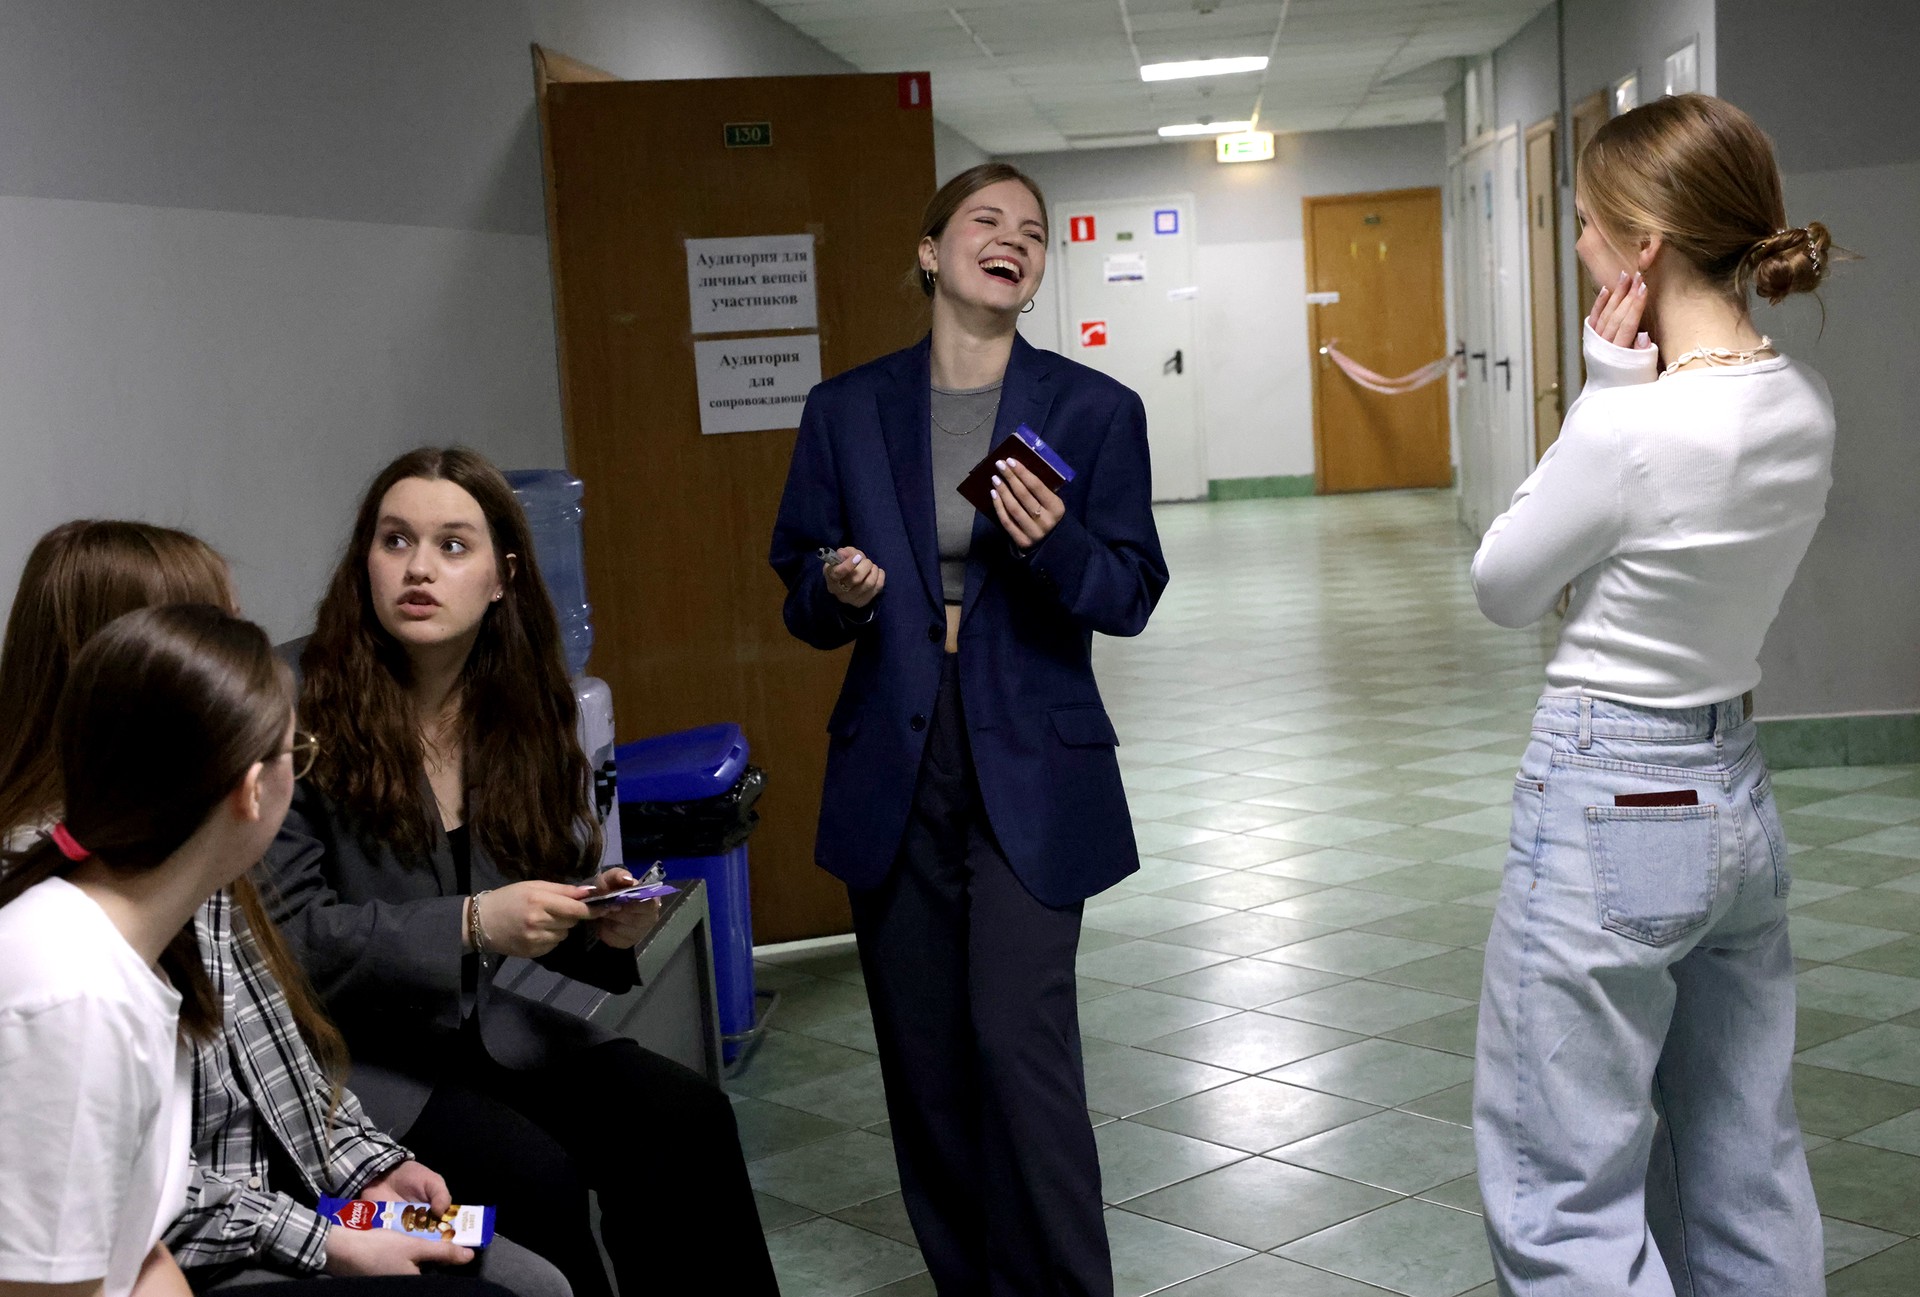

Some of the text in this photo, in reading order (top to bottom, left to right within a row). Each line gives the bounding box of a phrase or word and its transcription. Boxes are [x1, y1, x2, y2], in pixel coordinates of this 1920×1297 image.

[735, 127, 761, 142] 130
[697, 251, 807, 268] Аудитория для
[699, 270, 807, 287] личных вещей
[712, 295, 798, 312] участников
[720, 352, 799, 369] Аудитория
[748, 376, 775, 389] для
[709, 394, 808, 409] сопровождающи
